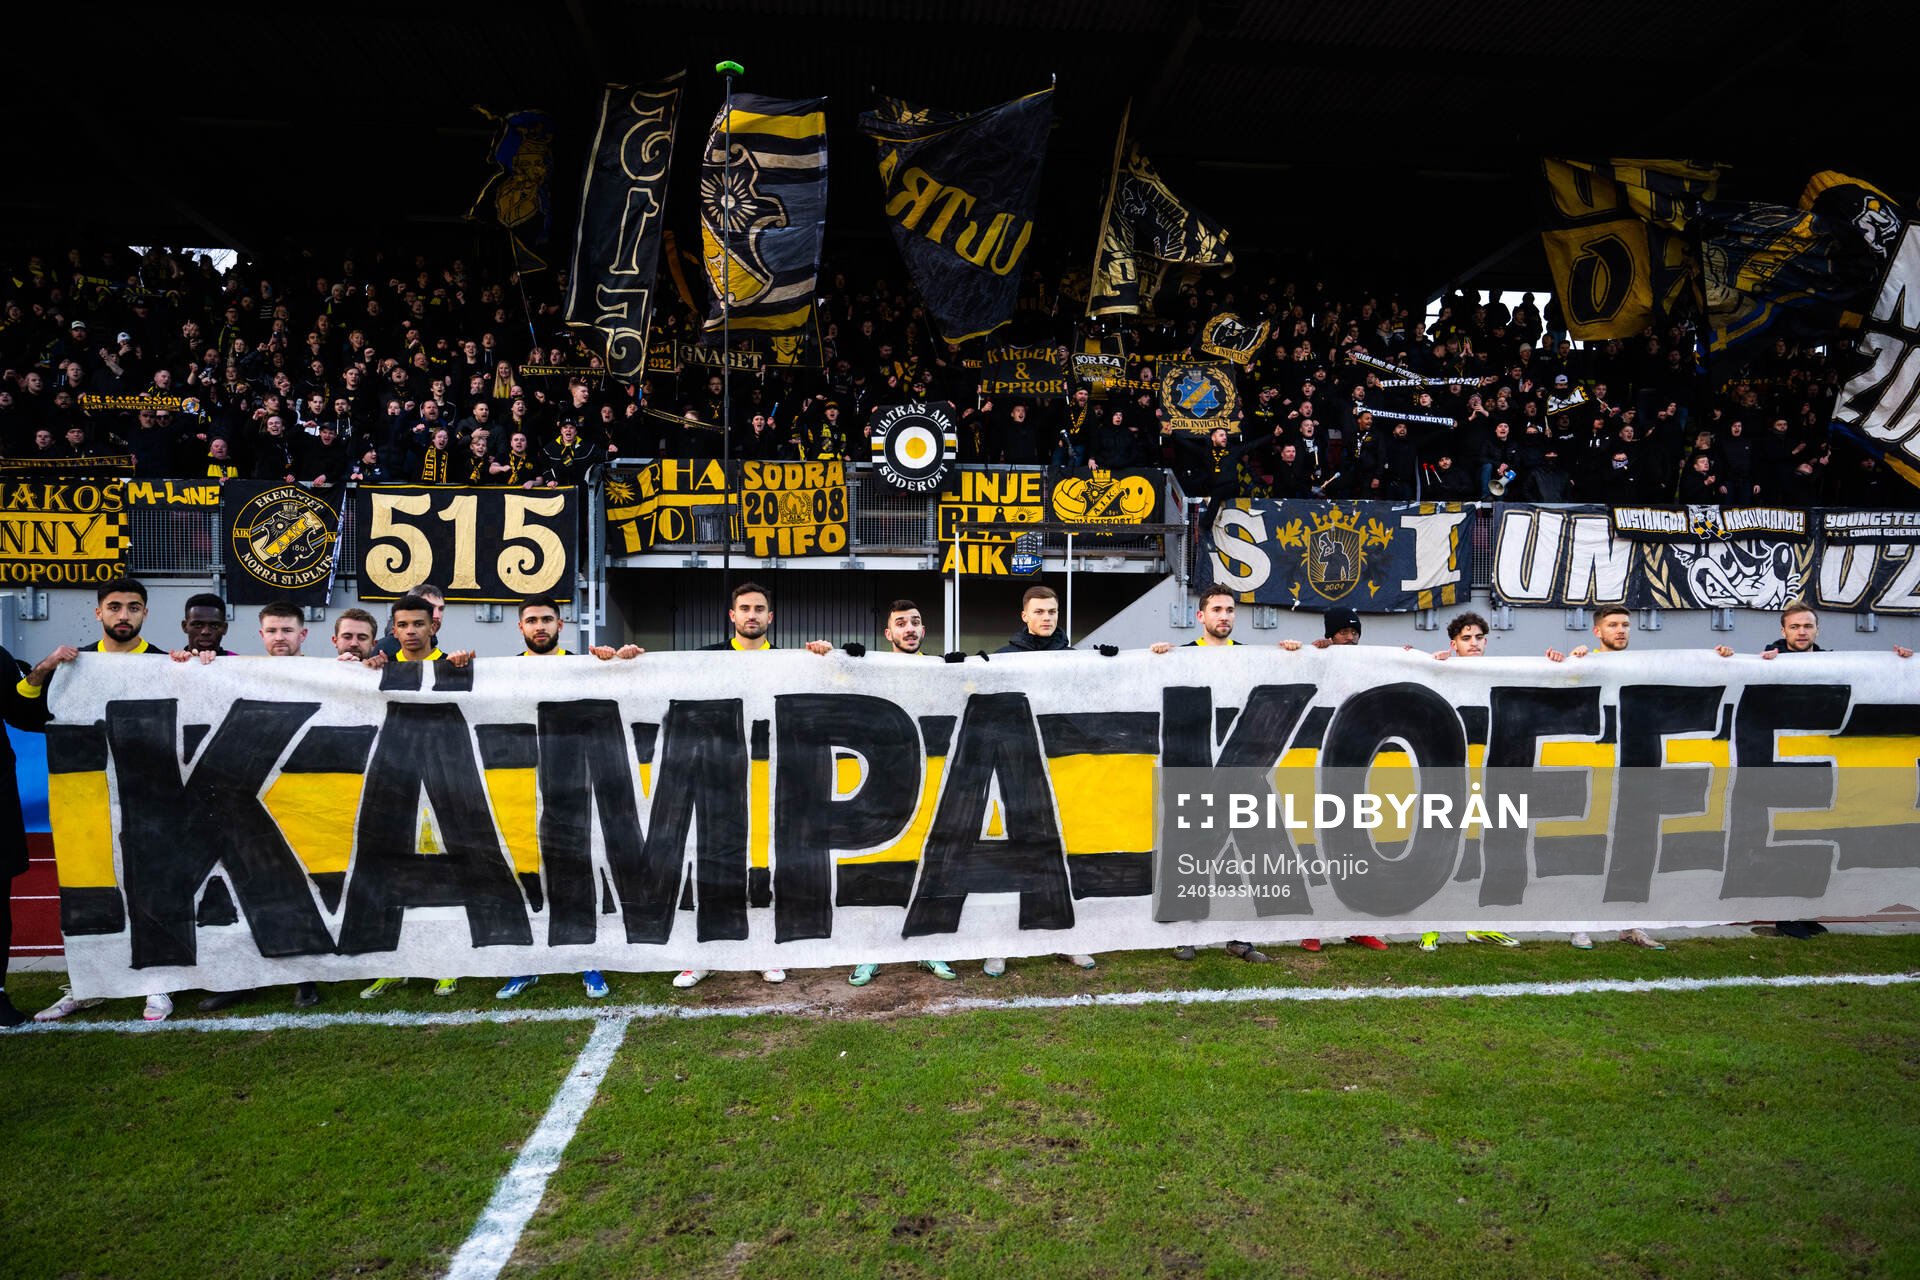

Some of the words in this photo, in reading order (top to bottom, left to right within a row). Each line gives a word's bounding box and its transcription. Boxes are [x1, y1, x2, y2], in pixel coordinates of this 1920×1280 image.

[1014, 361, 1031, 380] &
[1075, 354, 1121, 368] NORRA
[104, 395, 182, 407] KARLSSON
[876, 403, 927, 436] ULTRAS
[930, 409, 952, 432] AIK
[1171, 419, 1188, 428] SOL
[1190, 419, 1229, 429] INVICTUS
[878, 462, 948, 492] SÖDERORT
[745, 489, 779, 525] 20
[812, 488, 845, 523] 08
[366, 493, 567, 594] 515
[747, 523, 847, 557] TIFO
[1849, 528, 1882, 538] COMING
[942, 545, 1009, 575] AIK
[1209, 508, 1271, 592] S
[1401, 512, 1467, 591] I
[1496, 511, 1636, 603] UN
[242, 551, 278, 583] NORRA
[281, 554, 334, 585] STÅPLATS
[105, 660, 1075, 969] KÄMPA
[1155, 682, 1852, 922] KOFFE
